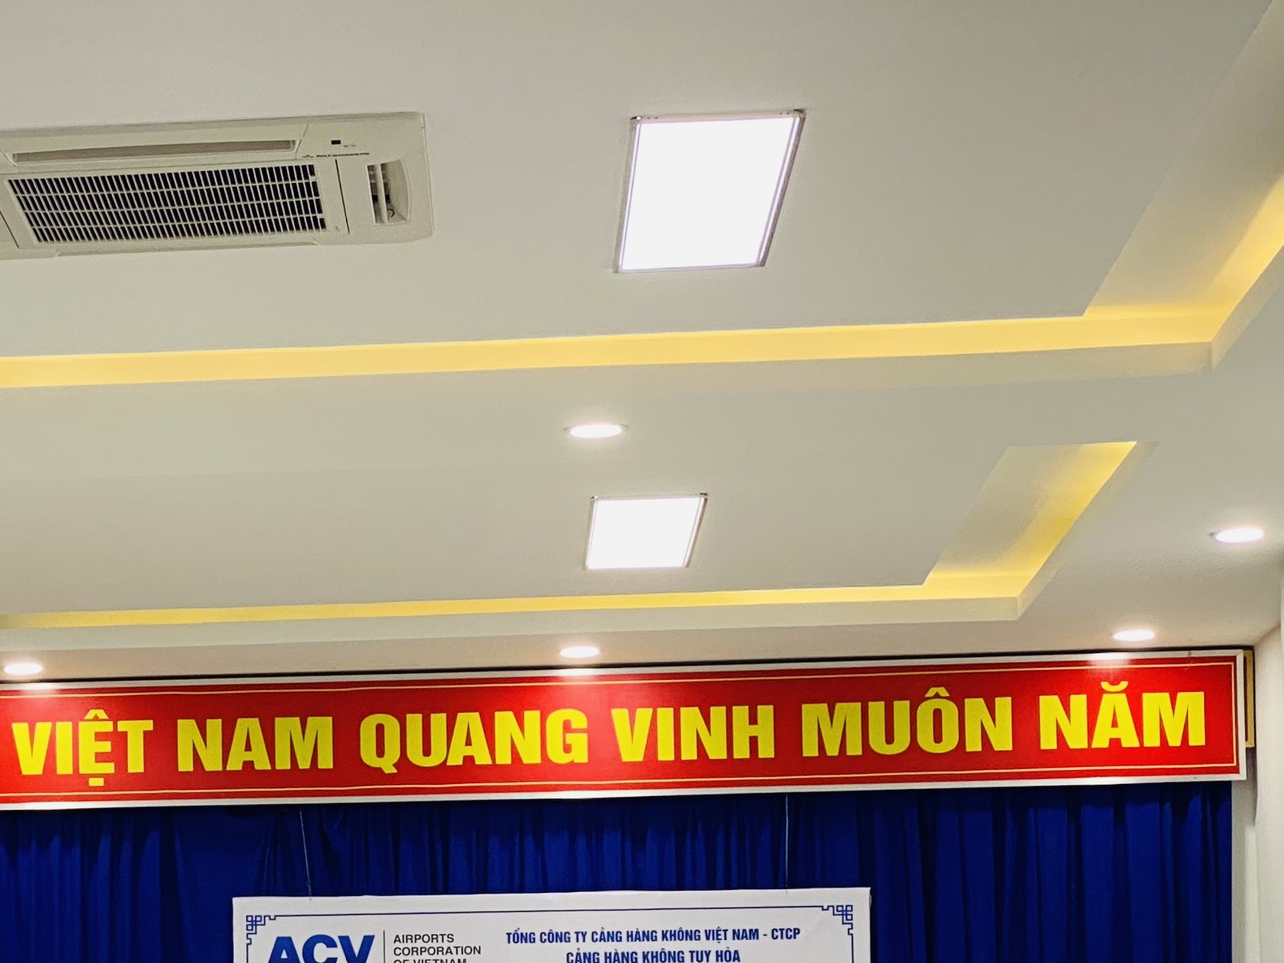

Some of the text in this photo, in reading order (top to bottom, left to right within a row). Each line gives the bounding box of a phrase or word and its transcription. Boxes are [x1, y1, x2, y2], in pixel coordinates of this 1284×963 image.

[13, 710, 153, 786] VIỆT
[178, 717, 333, 772] NAM
[361, 709, 588, 773] QUANG
[612, 705, 775, 762] VINH
[803, 688, 1013, 757] MUÔN
[1039, 682, 1205, 750] NĂM
[393, 933, 455, 944] AIRPORTS
[506, 928, 536, 944] TỔNG
[539, 930, 571, 944] CÔNG
[574, 931, 587, 943] TY
[591, 928, 622, 943] CẢNG
[626, 928, 658, 943] HÀNG
[661, 927, 701, 942] KHÔNG
[704, 926, 729, 944] VIỆT
[732, 929, 760, 941] NAM
[771, 928, 801, 941] CTCP
[393, 945, 481, 957] CORPORATION
[642, 947, 685, 963] KHÔNG
[689, 950, 711, 963] TUY
[715, 946, 741, 963] HÒA
